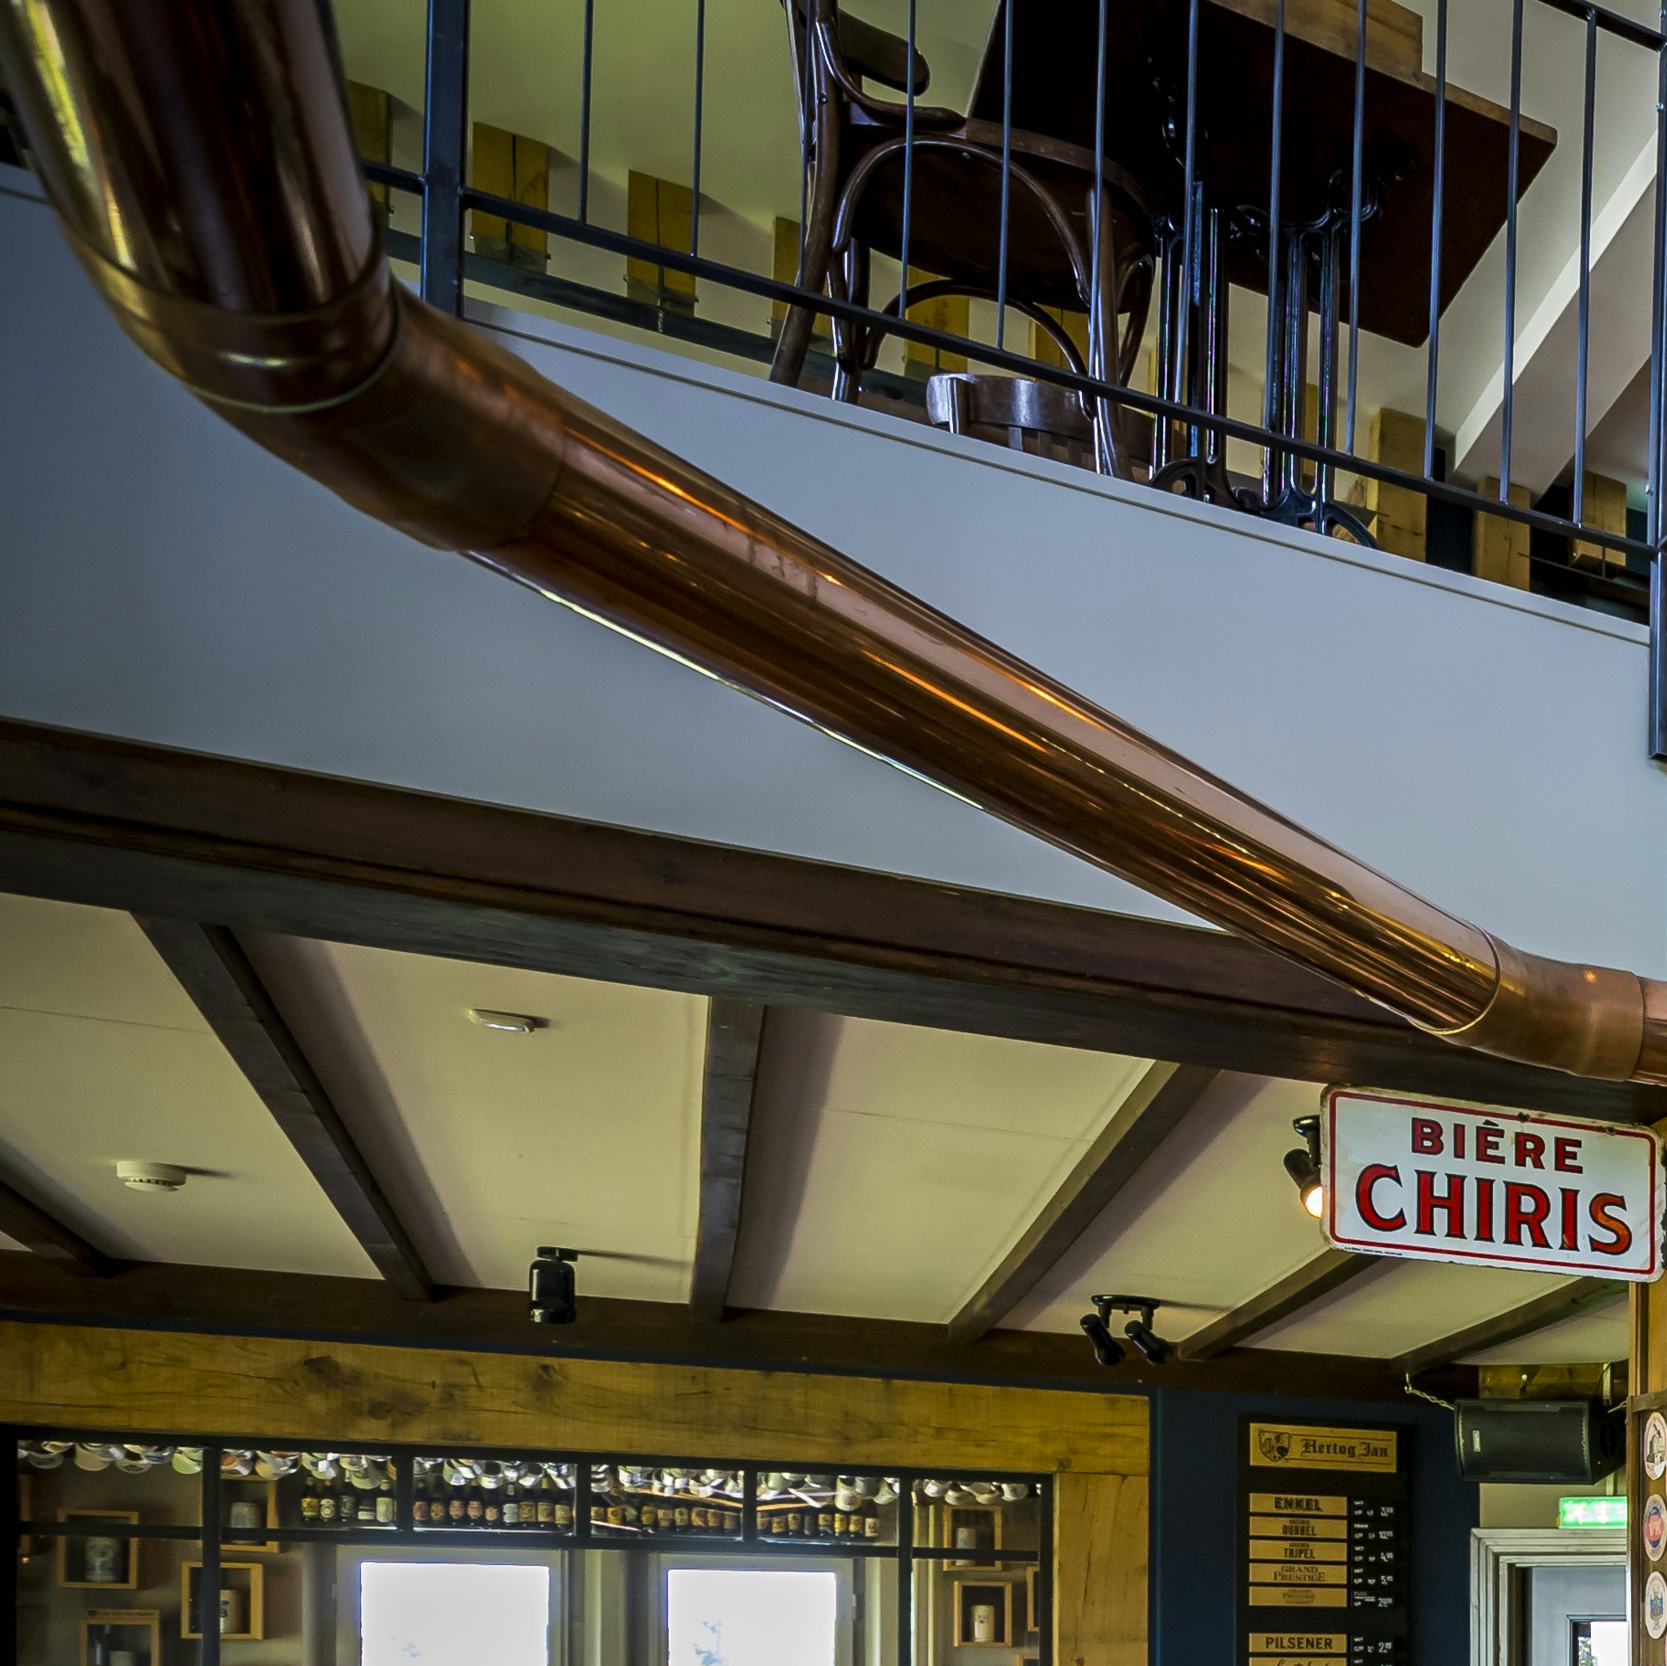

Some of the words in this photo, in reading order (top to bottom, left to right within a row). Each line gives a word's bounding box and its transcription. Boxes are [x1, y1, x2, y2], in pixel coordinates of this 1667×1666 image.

[1355, 1163, 1633, 1256] CHIRIS
[1301, 1438, 1357, 1458] Hertog
[1359, 1442, 1388, 1458] Jan
[1274, 1497, 1323, 1511] ENKEL
[1284, 1548, 1316, 1559] TRIPEL
[1281, 1565, 1318, 1573] GRAND
[1273, 1572, 1325, 1581] PRESTIGE
[1265, 1637, 1333, 1650] PILSENER
